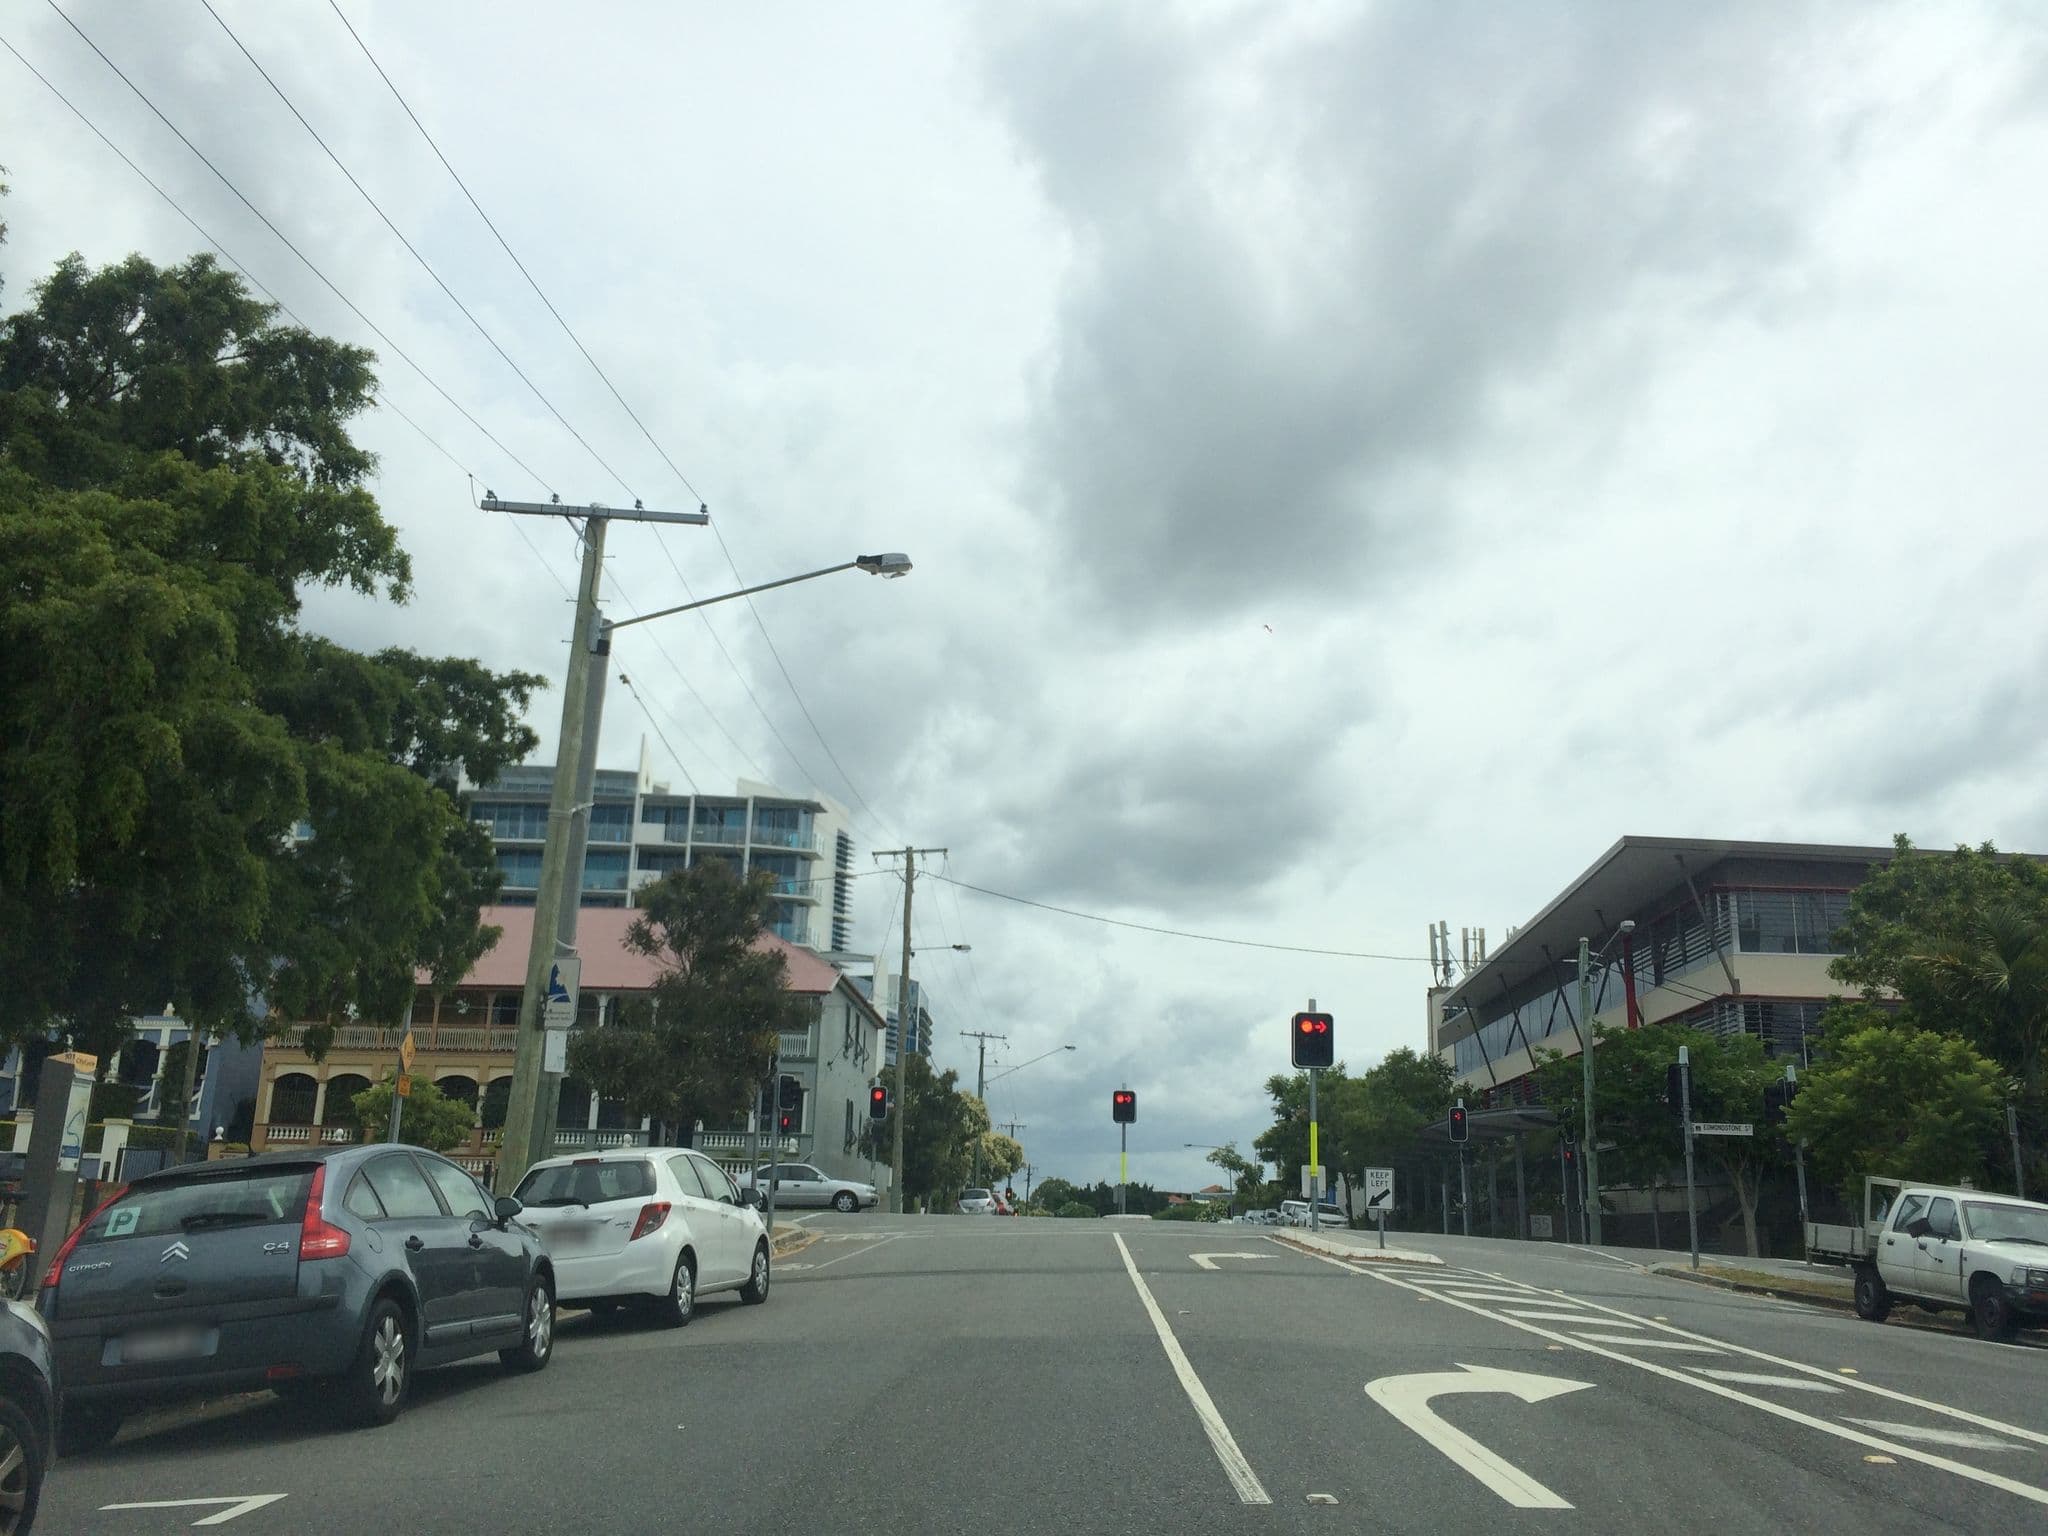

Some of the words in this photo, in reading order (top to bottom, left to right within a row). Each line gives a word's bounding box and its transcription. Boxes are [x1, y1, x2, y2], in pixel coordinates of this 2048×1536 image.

[1370, 1171, 1390, 1179] KEEP
[1370, 1180, 1389, 1188] LEFT
[111, 1211, 133, 1233] P
[263, 1241, 289, 1250] C4
